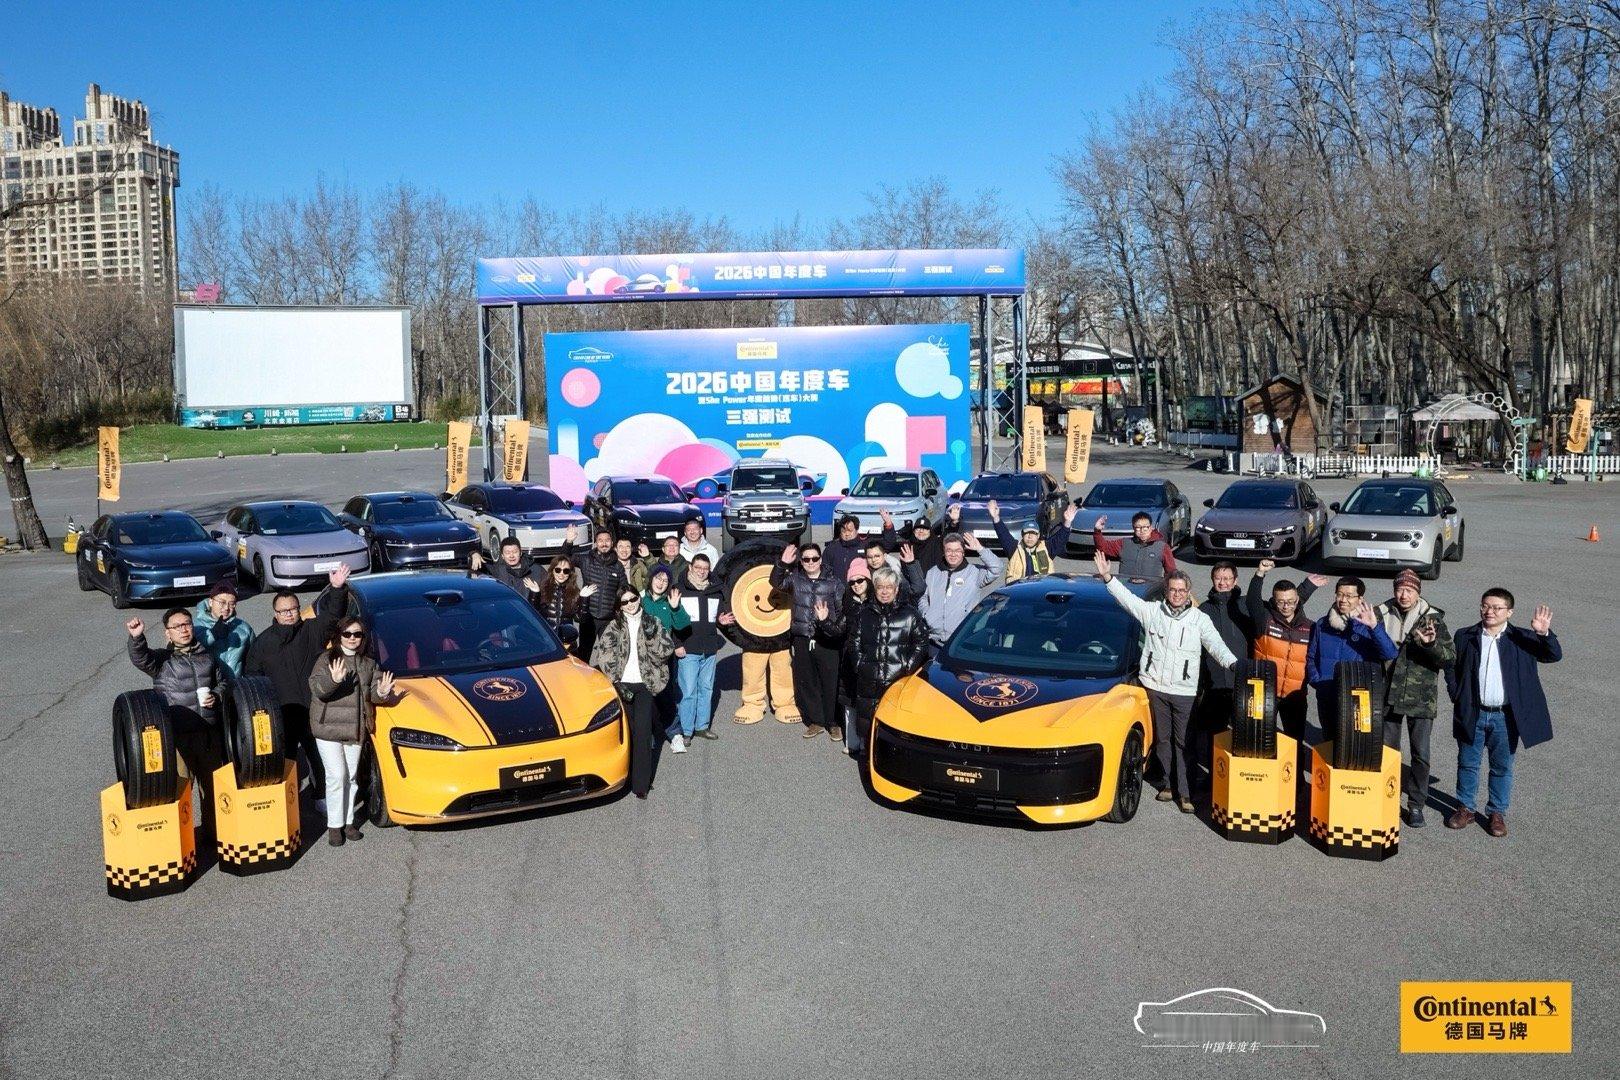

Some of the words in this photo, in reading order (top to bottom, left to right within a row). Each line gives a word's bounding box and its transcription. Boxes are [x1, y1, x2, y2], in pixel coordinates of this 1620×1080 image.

[714, 264, 828, 281] 2026中国年度车
[666, 368, 850, 395] 2026中国年度车
[726, 407, 792, 425] 三强测试
[1069, 430, 1081, 472] Continental
[513, 766, 547, 779] Continental
[946, 768, 978, 779] Continental
